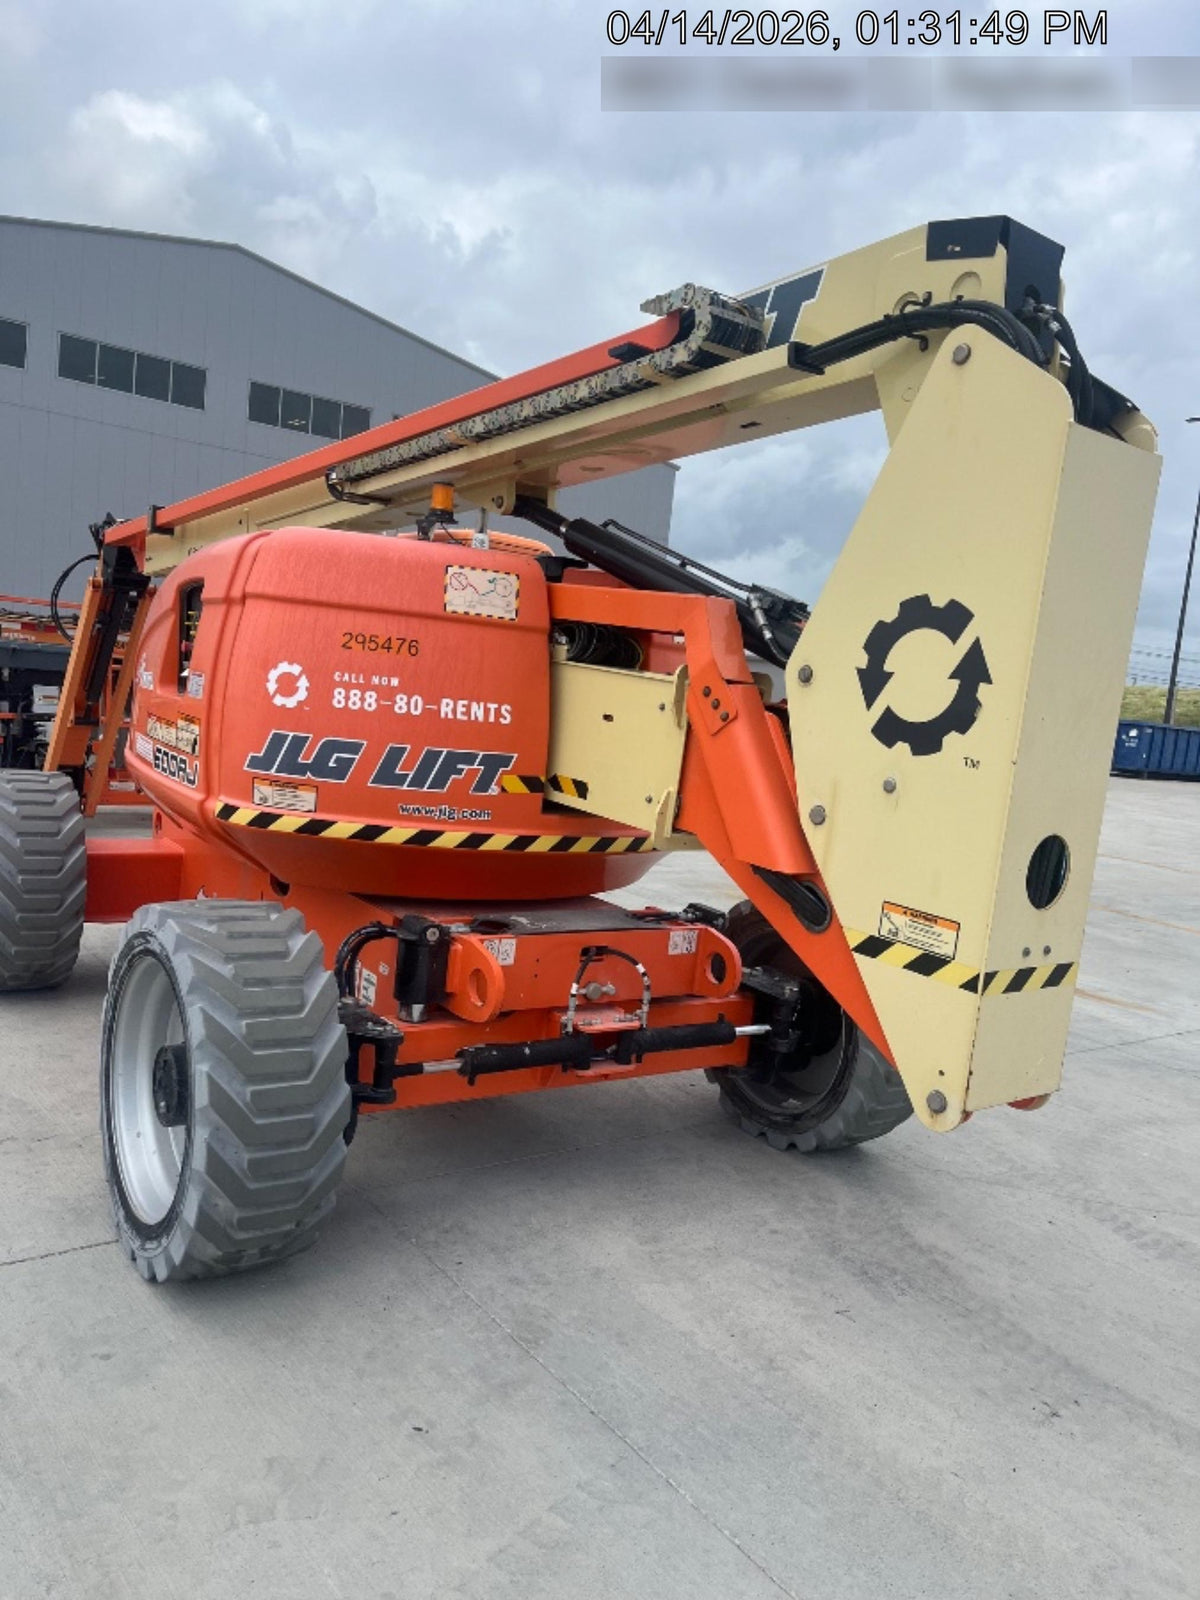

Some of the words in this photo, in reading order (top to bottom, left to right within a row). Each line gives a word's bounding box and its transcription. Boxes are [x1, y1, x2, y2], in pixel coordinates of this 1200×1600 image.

[341, 632, 419, 656] 295476
[334, 671, 366, 684] CALL
[371, 675, 399, 687] NOW
[332, 687, 512, 724] 888-80-RENTS
[243, 729, 367, 783] JLG
[368, 744, 518, 795] LIFT
